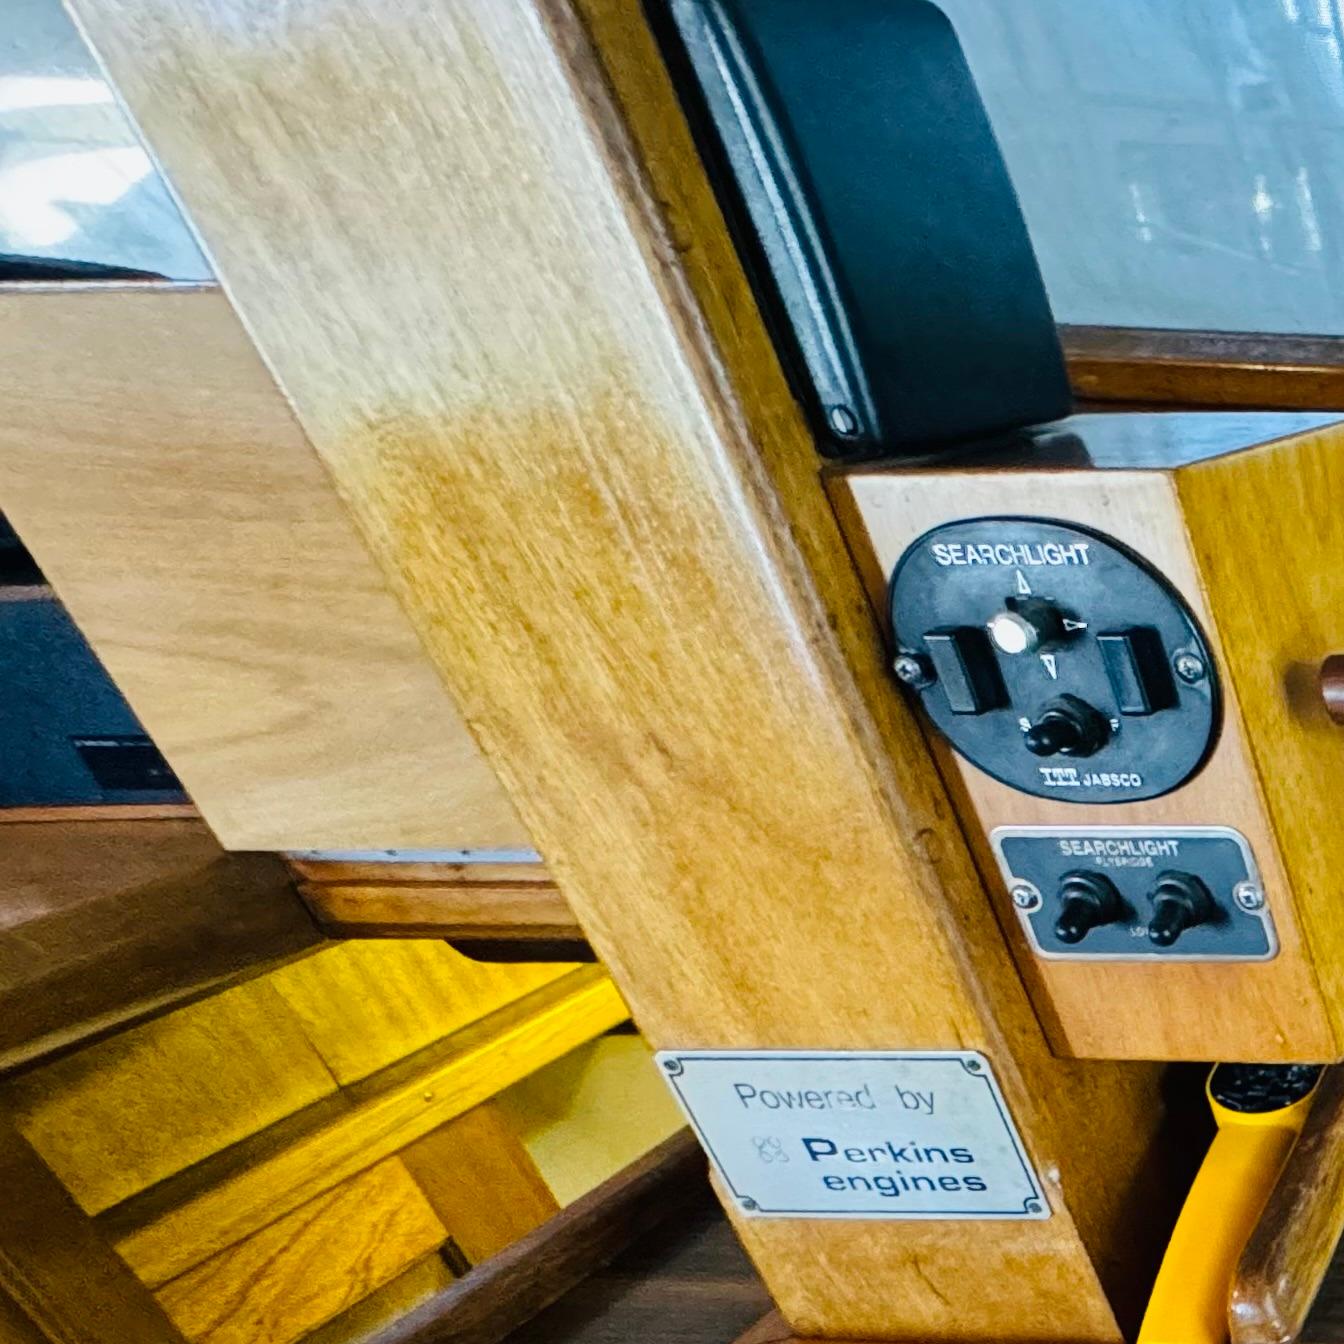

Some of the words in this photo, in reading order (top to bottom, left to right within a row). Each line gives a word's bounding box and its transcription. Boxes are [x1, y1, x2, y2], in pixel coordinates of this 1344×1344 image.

[932, 543, 1089, 566] SEARCHLIGHT
[1039, 767, 1081, 787] ITT
[1083, 772, 1142, 787] JABSCO
[1059, 840, 1179, 856] SEARCHLIGHT
[733, 1083, 876, 1110] Powered
[895, 1085, 936, 1115] by
[801, 1137, 975, 1164] Perkins
[822, 1171, 988, 1197] engines
